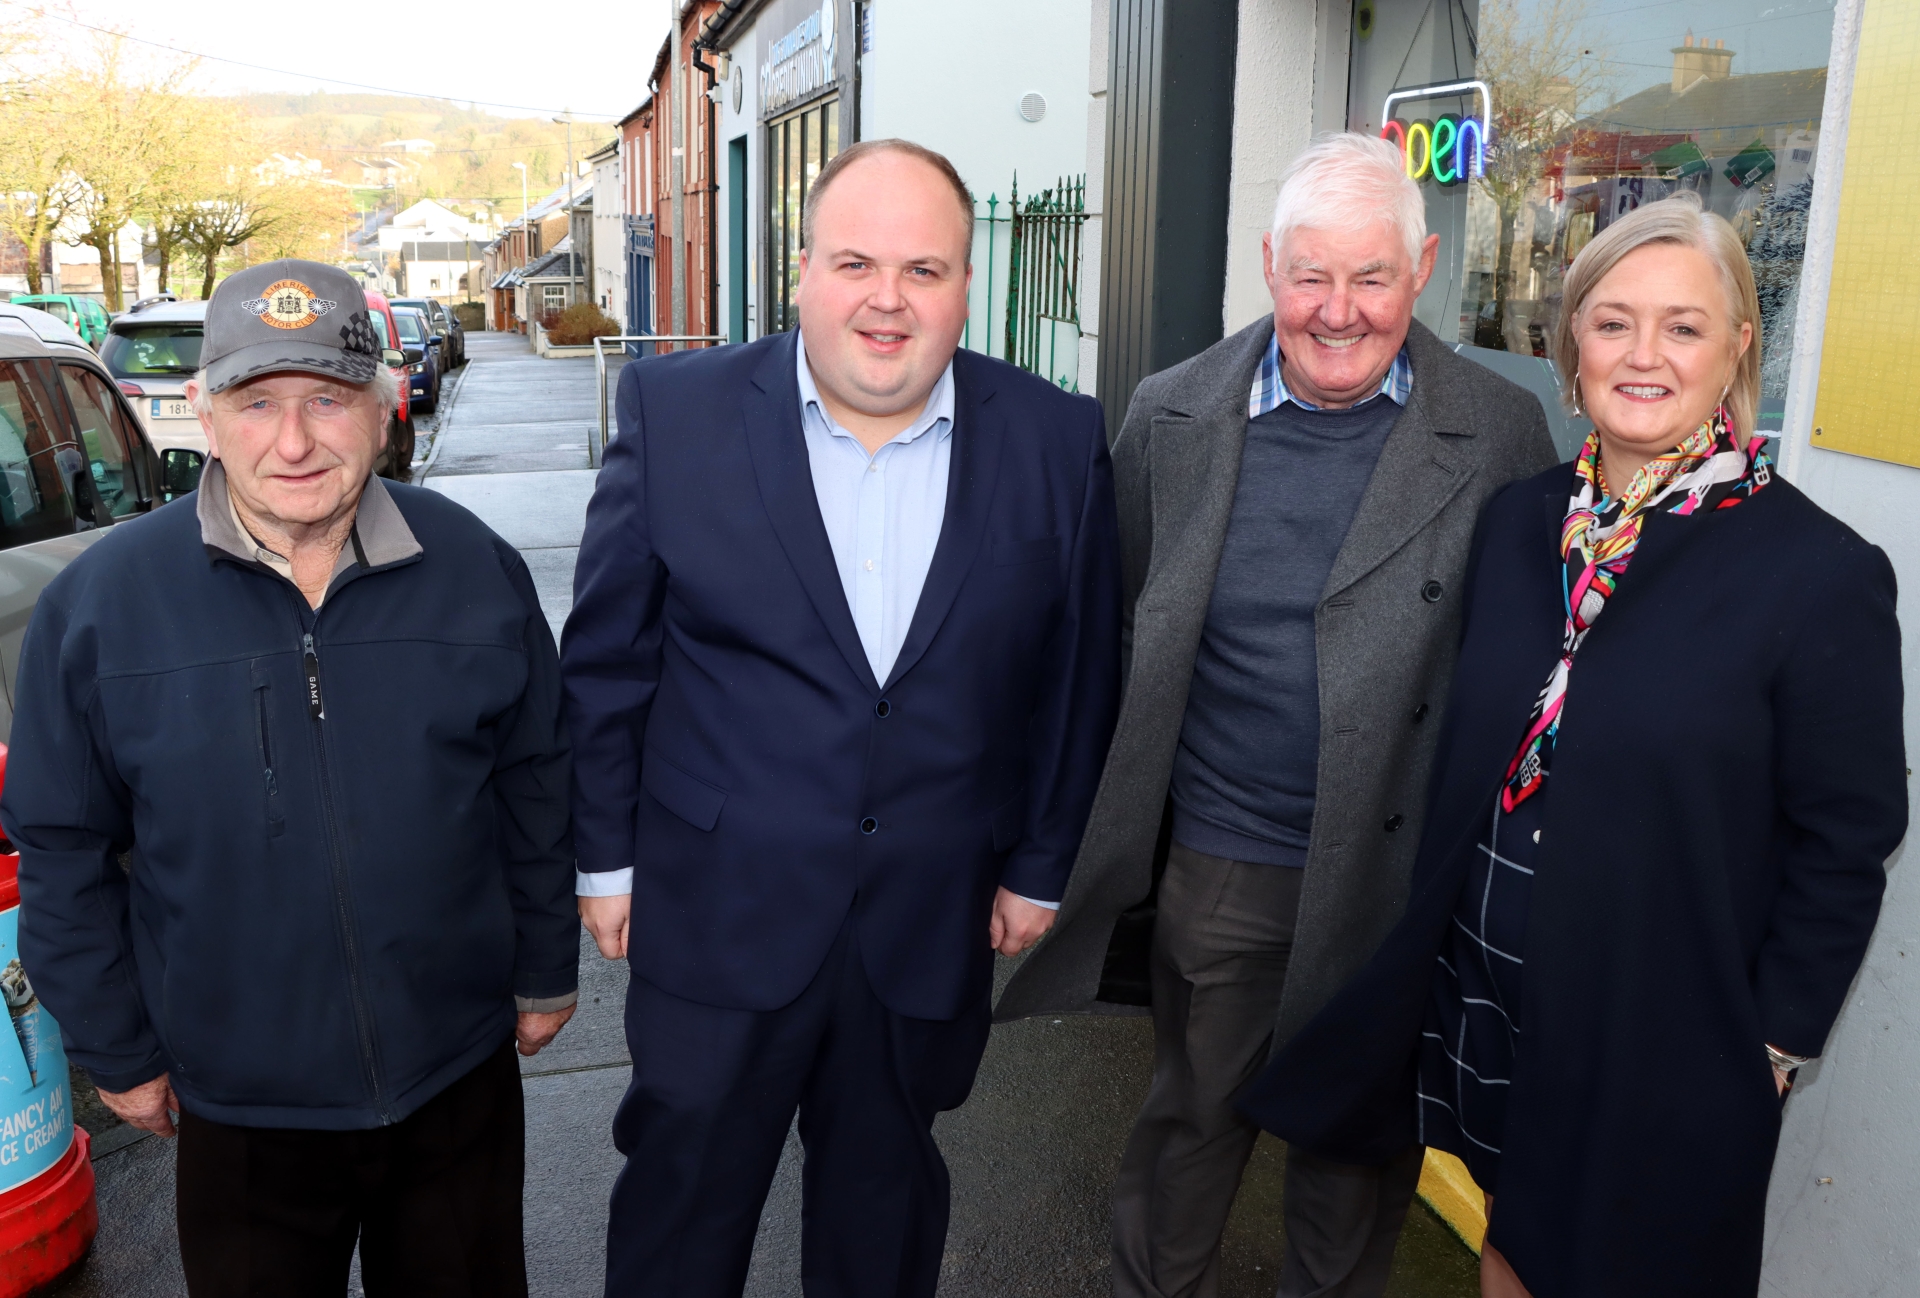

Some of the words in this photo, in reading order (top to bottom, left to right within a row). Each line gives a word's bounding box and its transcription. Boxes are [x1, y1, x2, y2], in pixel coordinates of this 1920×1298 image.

[772, 59, 795, 110] CREDIT
[796, 42, 820, 97] UNION
[265, 281, 313, 297] LIMERICK
[262, 312, 292, 328] MOTOR
[295, 313, 316, 328] CLUB
[309, 676, 319, 705] GAME
[50, 1083, 63, 1116] AN
[0, 1141, 19, 1166] CE
[24, 1108, 65, 1155] CREAM?
